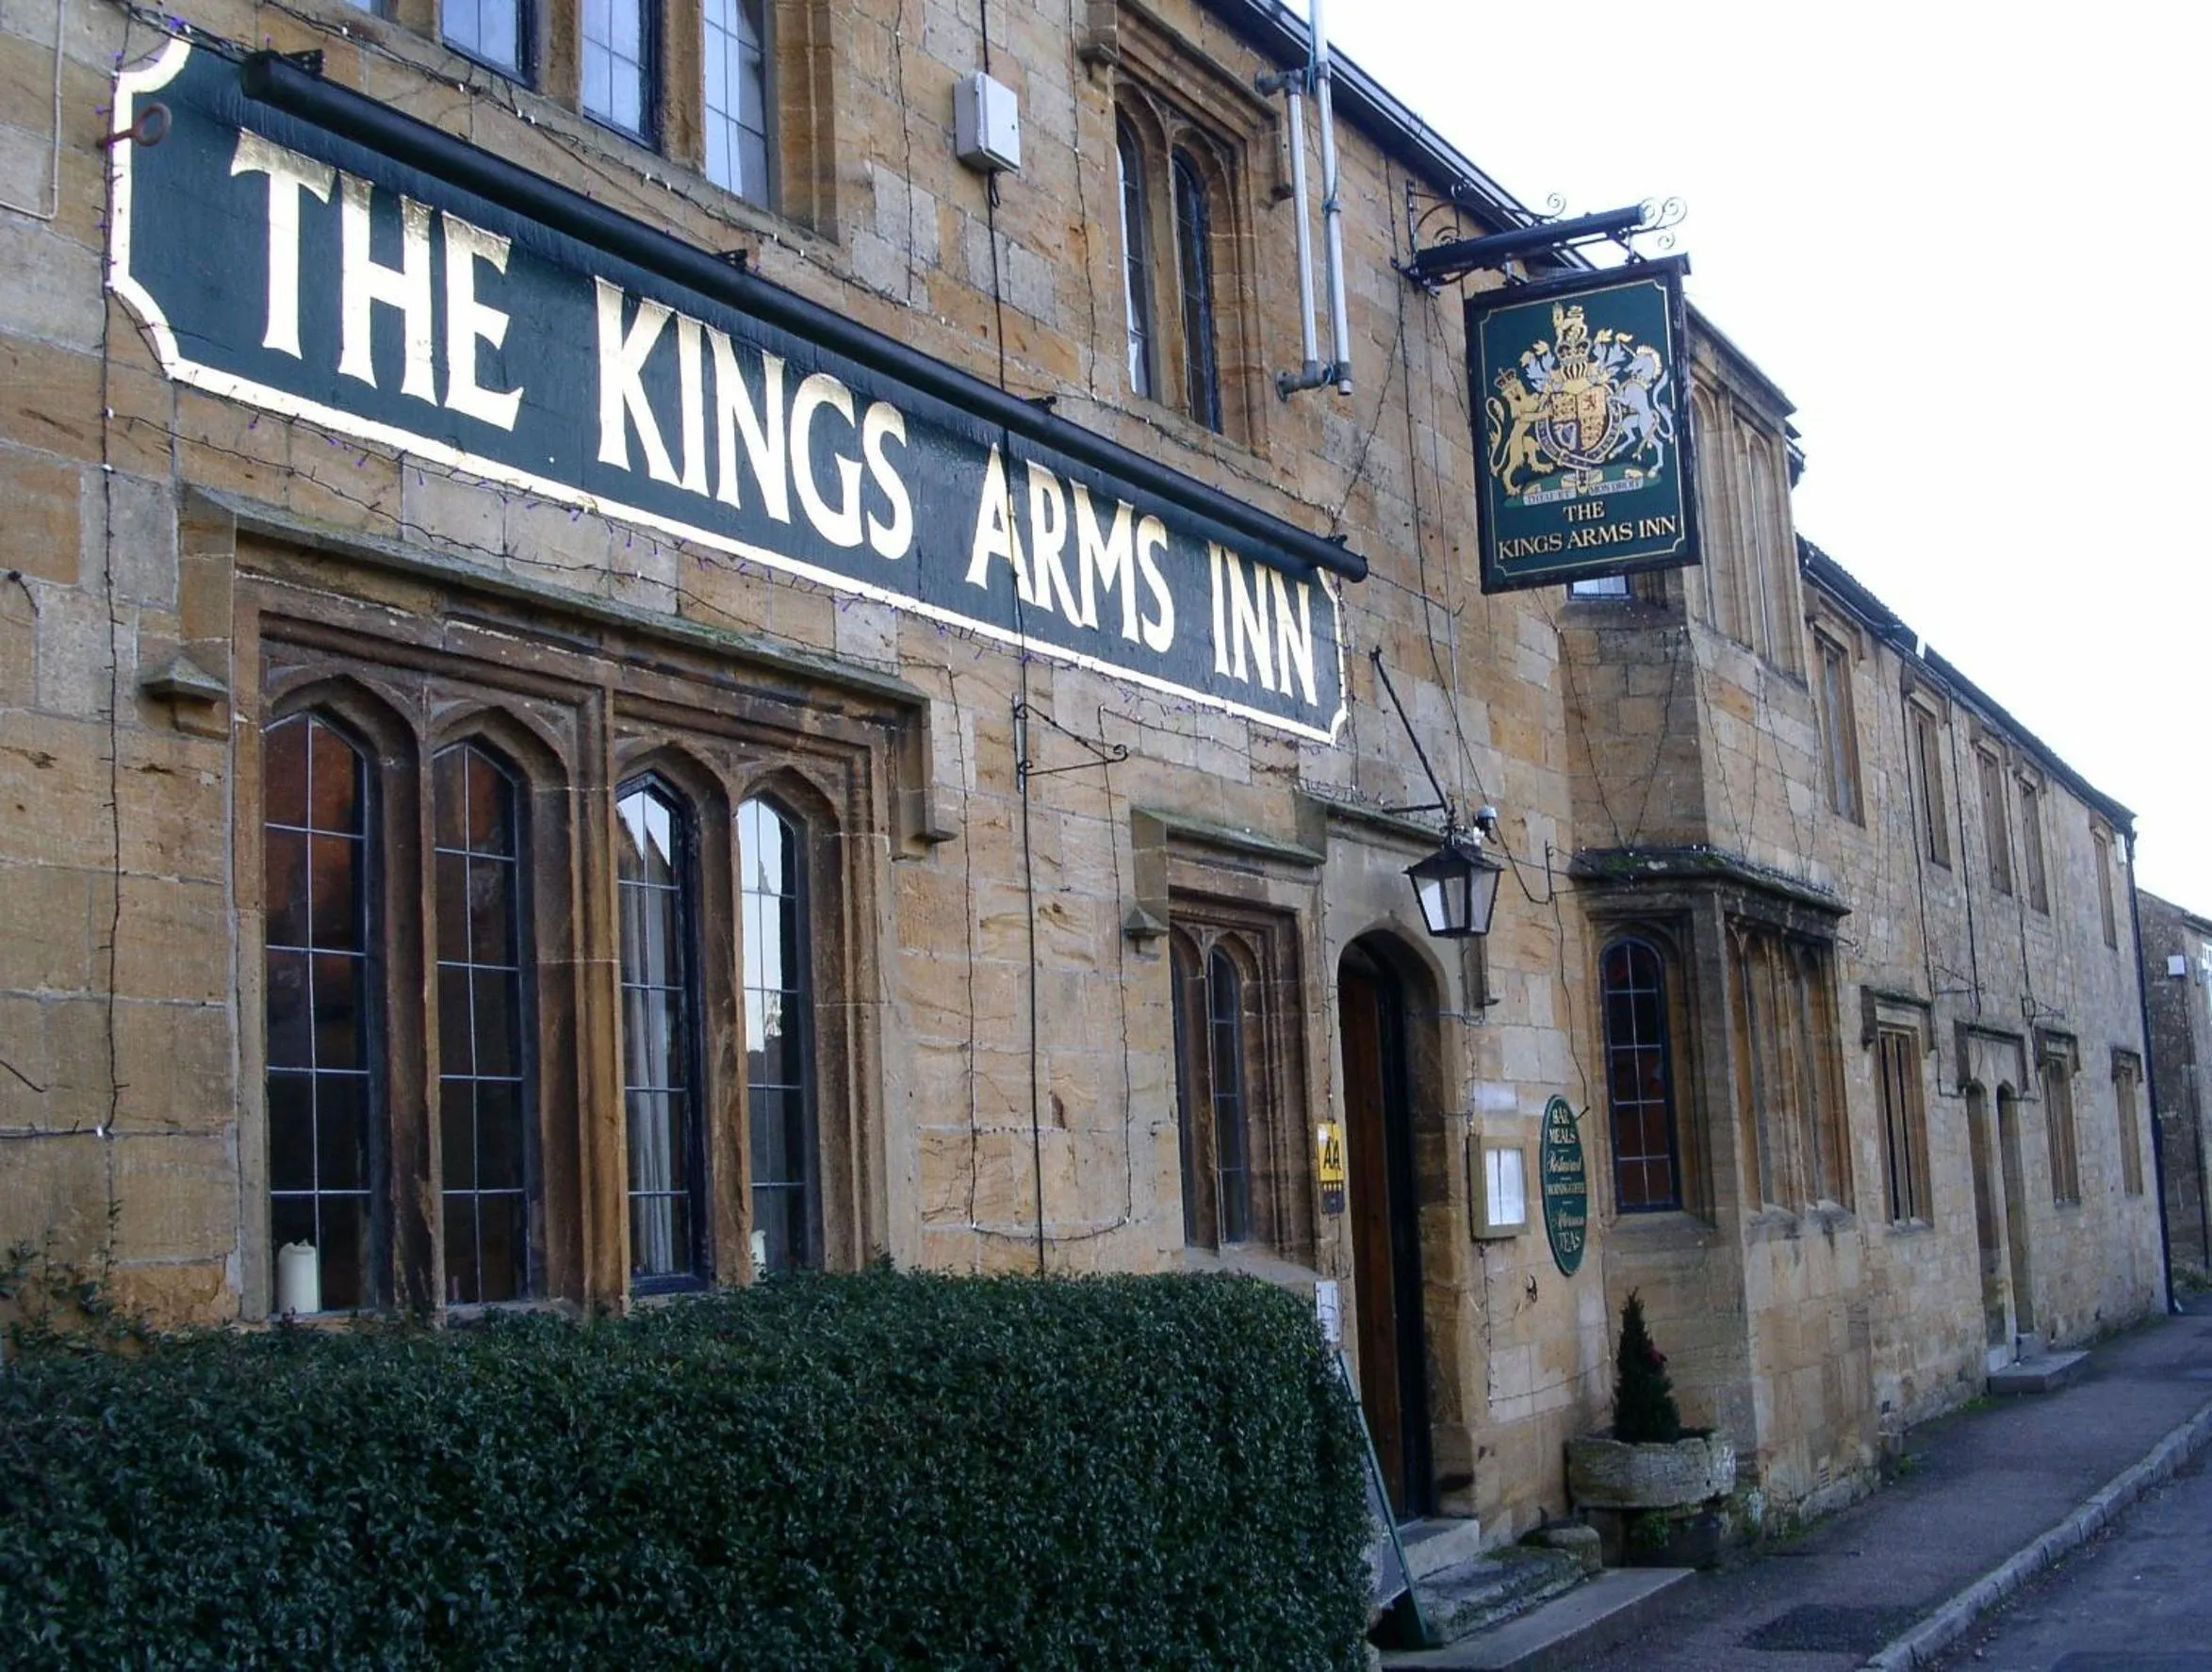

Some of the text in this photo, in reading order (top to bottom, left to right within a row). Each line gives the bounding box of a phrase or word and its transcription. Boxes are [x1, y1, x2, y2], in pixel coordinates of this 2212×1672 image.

[231, 127, 1318, 707] THE KINGS ARMS INN
[1563, 501, 1606, 521] THE
[1499, 516, 1676, 560] KINGS ARMS INN
[1323, 1135, 1341, 1171] AA
